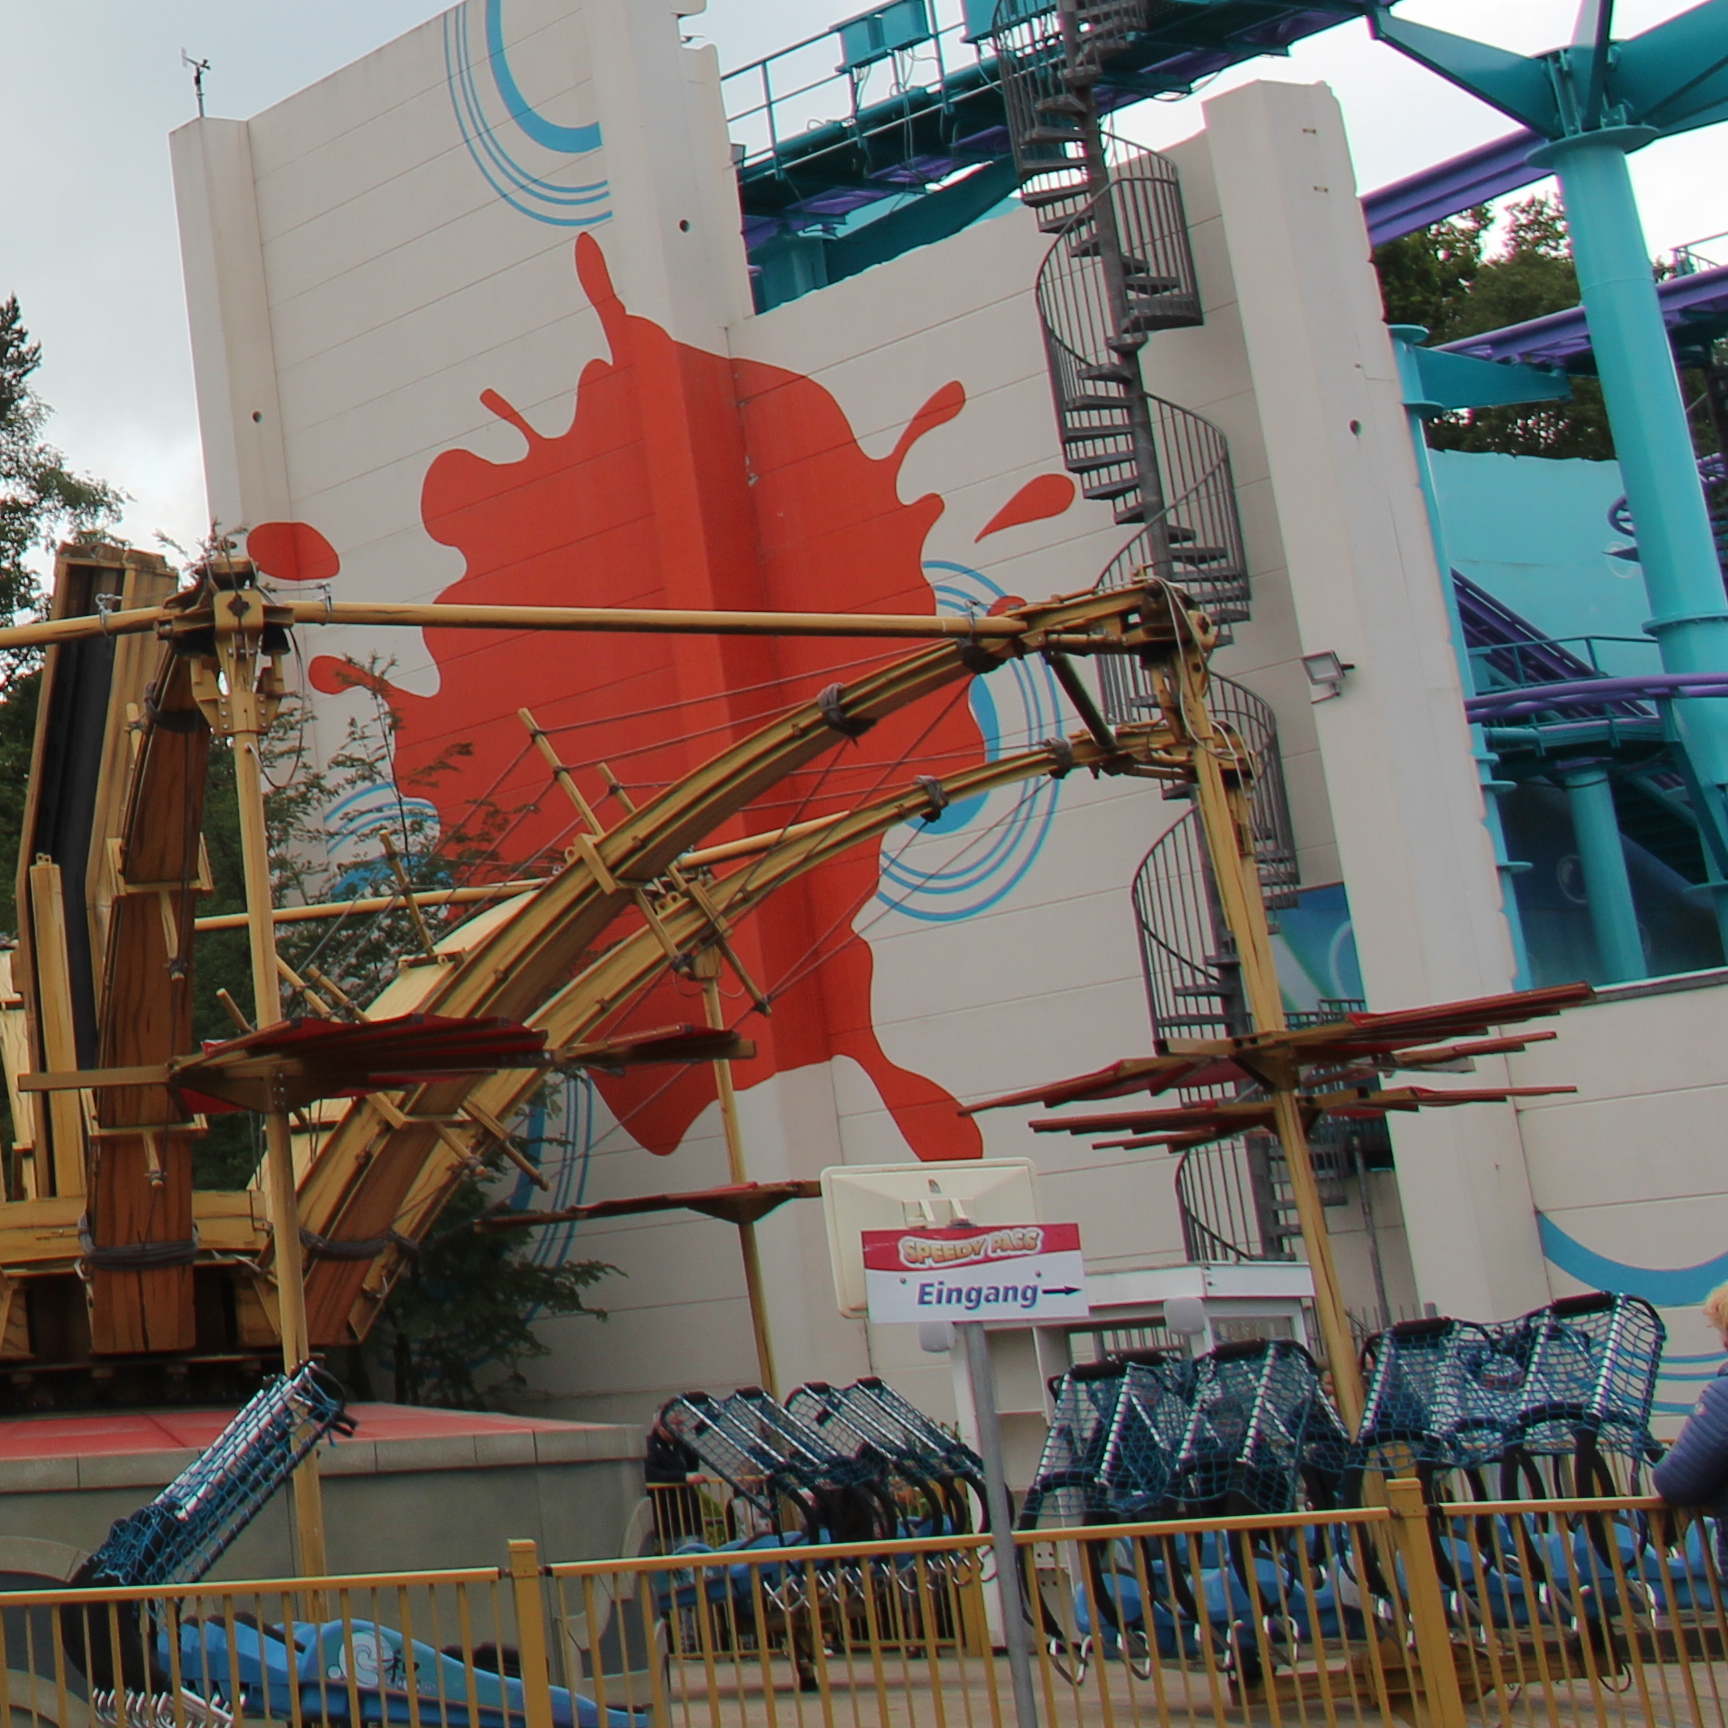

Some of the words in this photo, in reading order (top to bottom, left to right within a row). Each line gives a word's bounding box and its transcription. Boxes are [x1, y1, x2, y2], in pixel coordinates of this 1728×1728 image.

[900, 1236, 986, 1265] SPEEDY
[990, 1229, 1041, 1254] PASS
[917, 1281, 1038, 1310] Eingang
